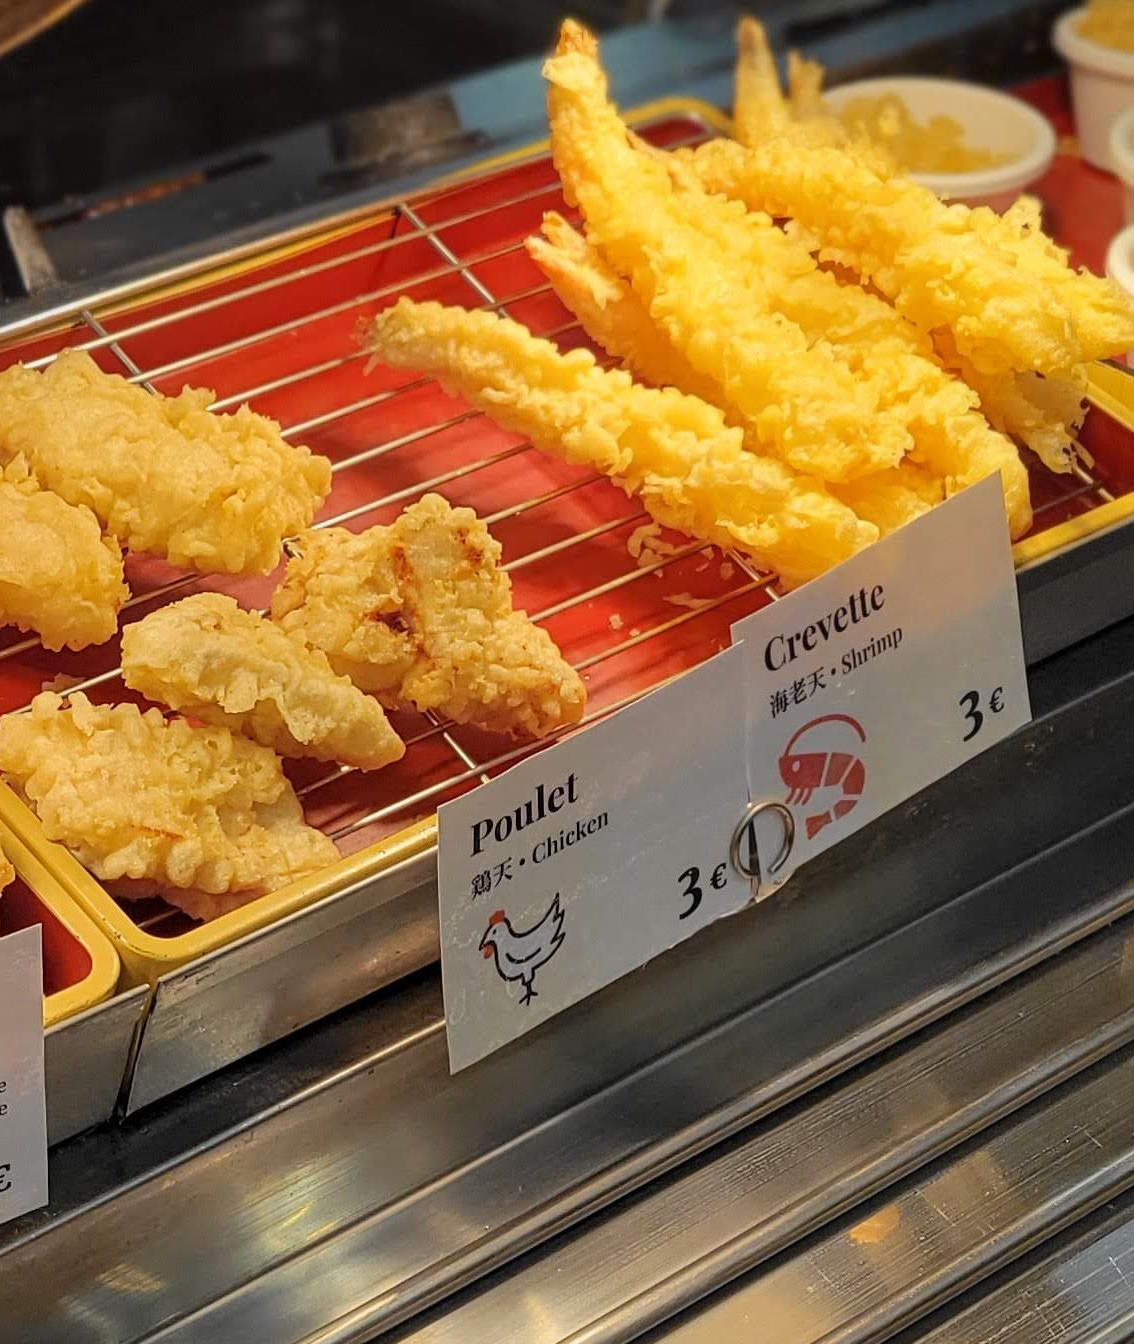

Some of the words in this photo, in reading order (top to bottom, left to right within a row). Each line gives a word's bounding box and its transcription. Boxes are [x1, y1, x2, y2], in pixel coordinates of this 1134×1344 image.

[763, 580, 887, 673] Crevette
[769, 668, 827, 719] 海老天
[840, 625, 904, 678] Shrimp
[470, 772, 580, 857] Poulet
[470, 857, 514, 901] 鶏天
[531, 811, 610, 867] Chicken
